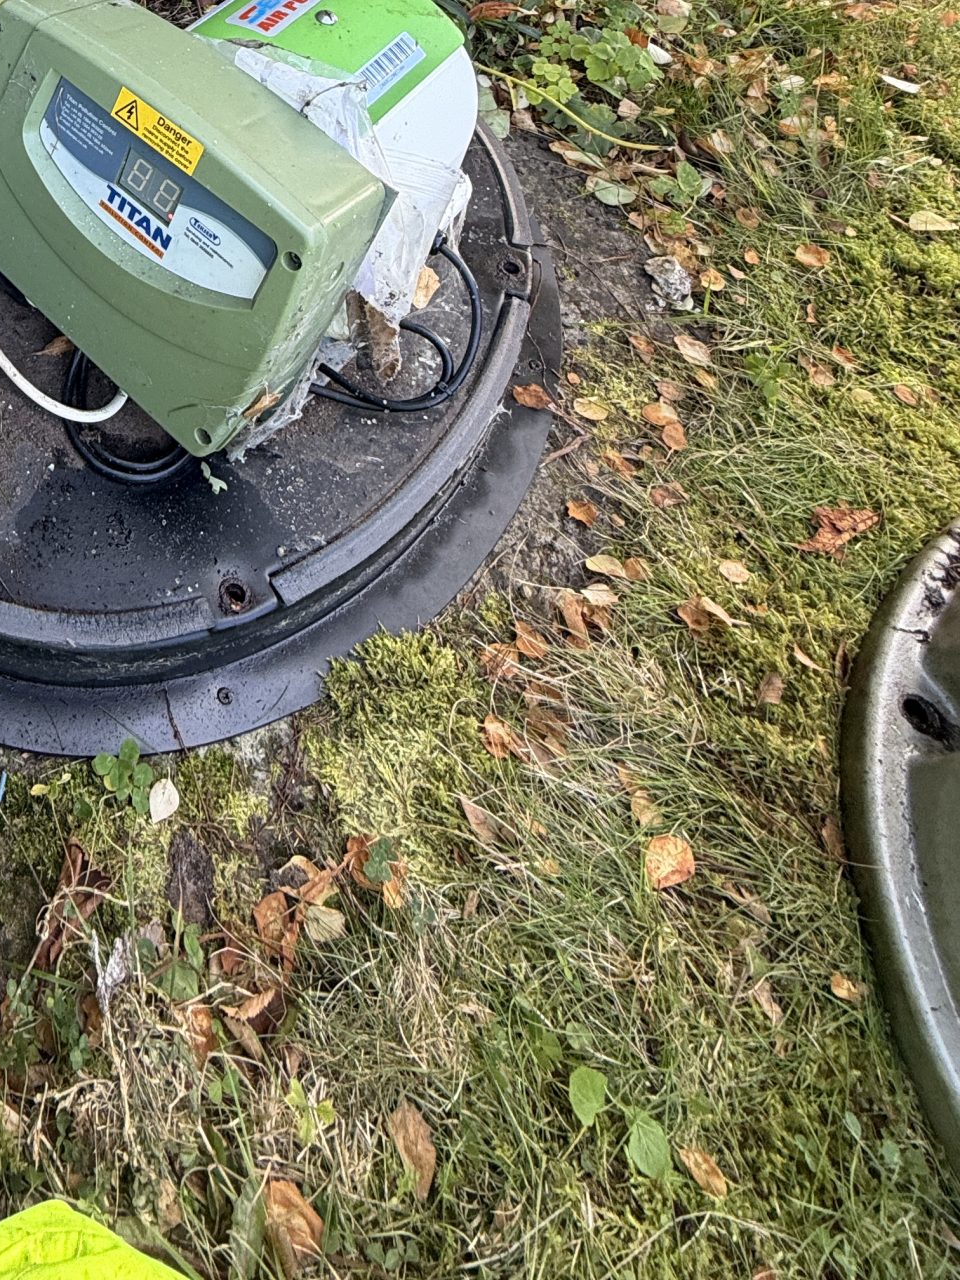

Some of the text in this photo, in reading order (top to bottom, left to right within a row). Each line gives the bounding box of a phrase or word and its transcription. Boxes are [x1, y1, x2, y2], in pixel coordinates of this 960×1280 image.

[256, 8, 289, 31] AIR
[66, 93, 77, 105] Titan
[78, 103, 98, 122] Pollution
[98, 119, 117, 136] Control
[156, 116, 192, 146] Danger
[141, 132, 189, 169] removing this cover
[143, 126, 192, 164] mains supply before
[152, 125, 189, 154] Disconnect the
[107, 184, 172, 251] TITAN
[134, 230, 163, 258] CONTROL
